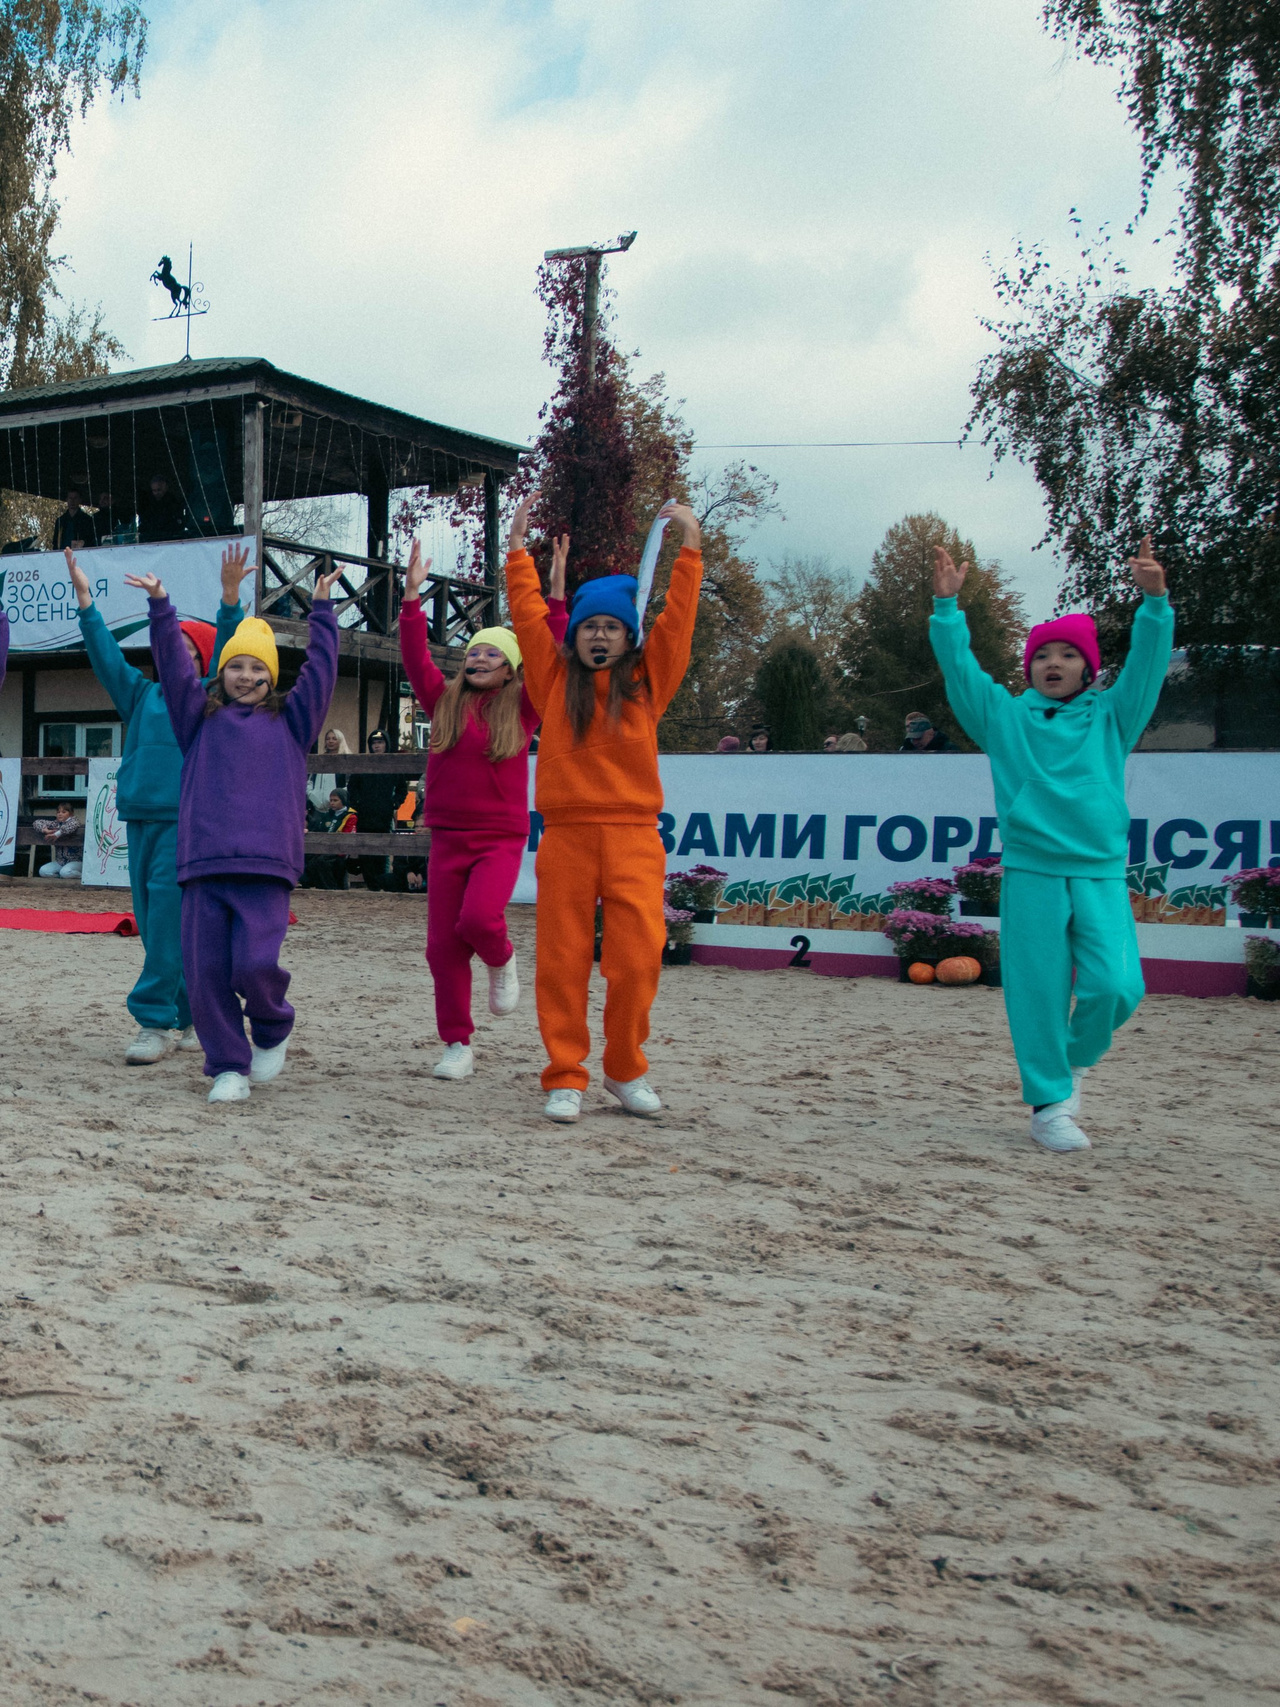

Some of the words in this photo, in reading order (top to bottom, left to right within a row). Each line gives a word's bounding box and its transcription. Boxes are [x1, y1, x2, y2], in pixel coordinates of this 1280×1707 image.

[7, 570, 40, 583] 2026
[7, 579, 108, 604] ЗОЛОТЯ
[6, 602, 78, 624] ОСЕНЬ
[789, 935, 811, 967] 2
